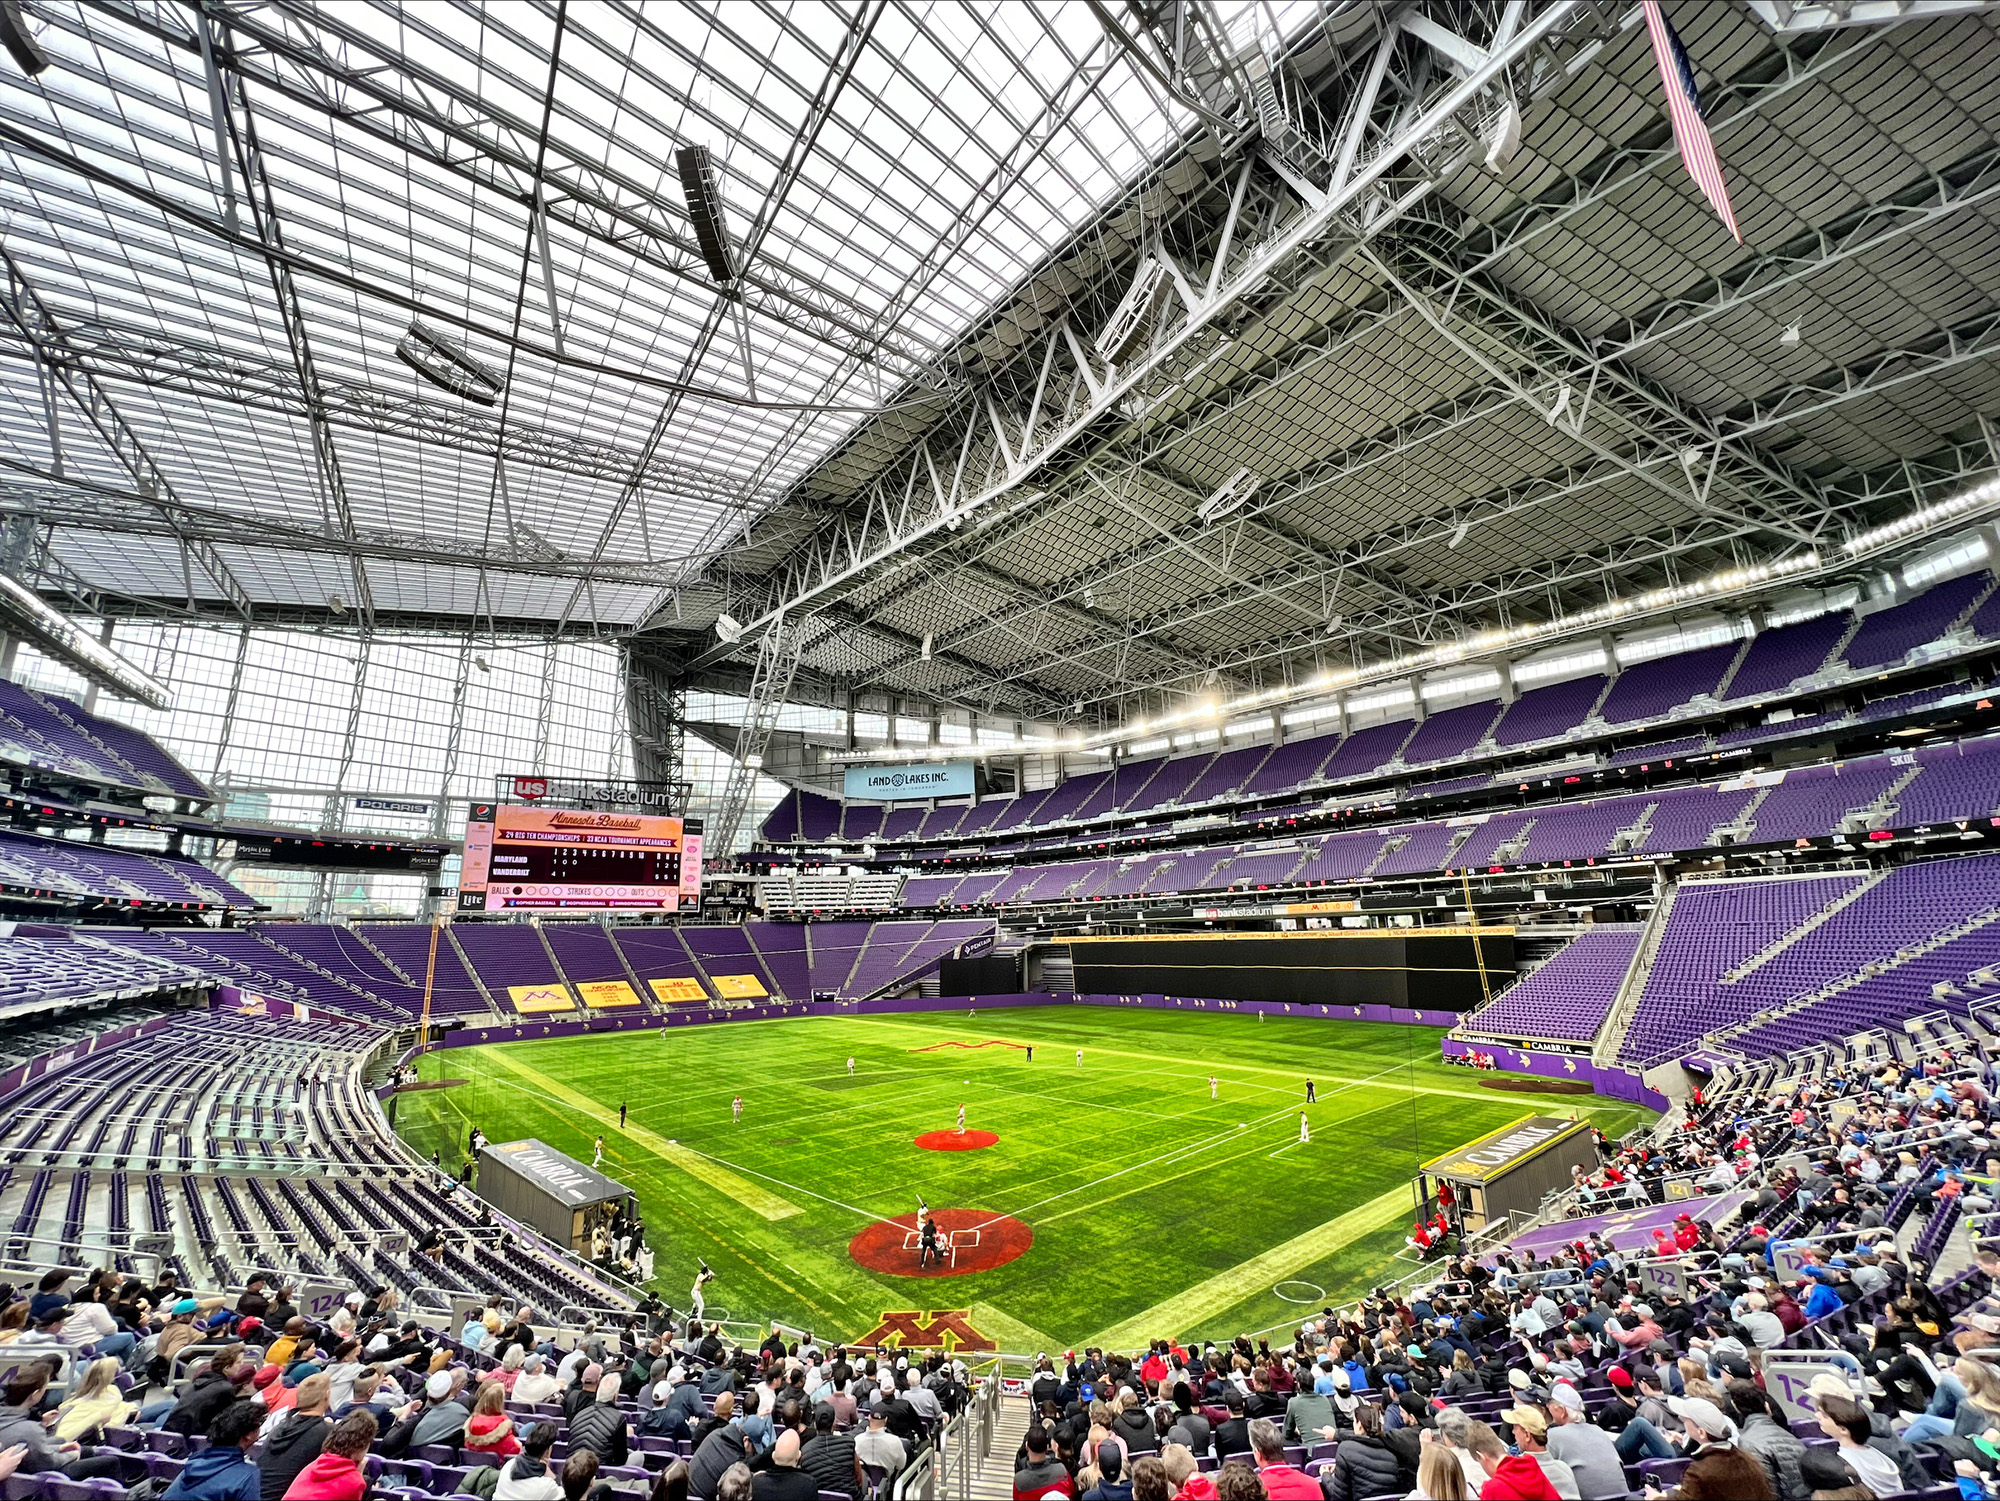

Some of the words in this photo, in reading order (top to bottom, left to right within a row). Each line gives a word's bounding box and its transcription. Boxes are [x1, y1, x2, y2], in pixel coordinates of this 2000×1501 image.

[1720, 748, 1752, 758] CAMBRIA
[1890, 754, 1917, 766] SKOL
[868, 776, 891, 787] LAND
[931, 772, 949, 782] INC.
[360, 800, 424, 813] POLARIS
[549, 811, 595, 826] Minnesota
[598, 815, 641, 829] Baseball
[494, 855, 528, 864] MARYLAND
[1641, 852, 1674, 860] CAMBRIA
[493, 868, 530, 876] VANDERBILT
[492, 887, 510, 895] BALLS
[567, 888, 592, 896] STRIKES
[463, 895, 483, 906] Lite
[1462, 1035, 1496, 1045] CAMBRIA
[1532, 1041, 1572, 1053] CAMBRIA
[1834, 1104, 1855, 1115] 120
[1466, 1126, 1560, 1165] CAMBRIA
[511, 1149, 590, 1190] CAMBRIA
[1669, 1184, 1690, 1198] 121
[144, 1241, 168, 1254] 127
[385, 1237, 404, 1250] 127
[1782, 1254, 1804, 1271] 12
[1647, 1267, 1677, 1287] 122
[311, 1291, 346, 1314] 124
[1776, 1374, 1815, 1412] 12
